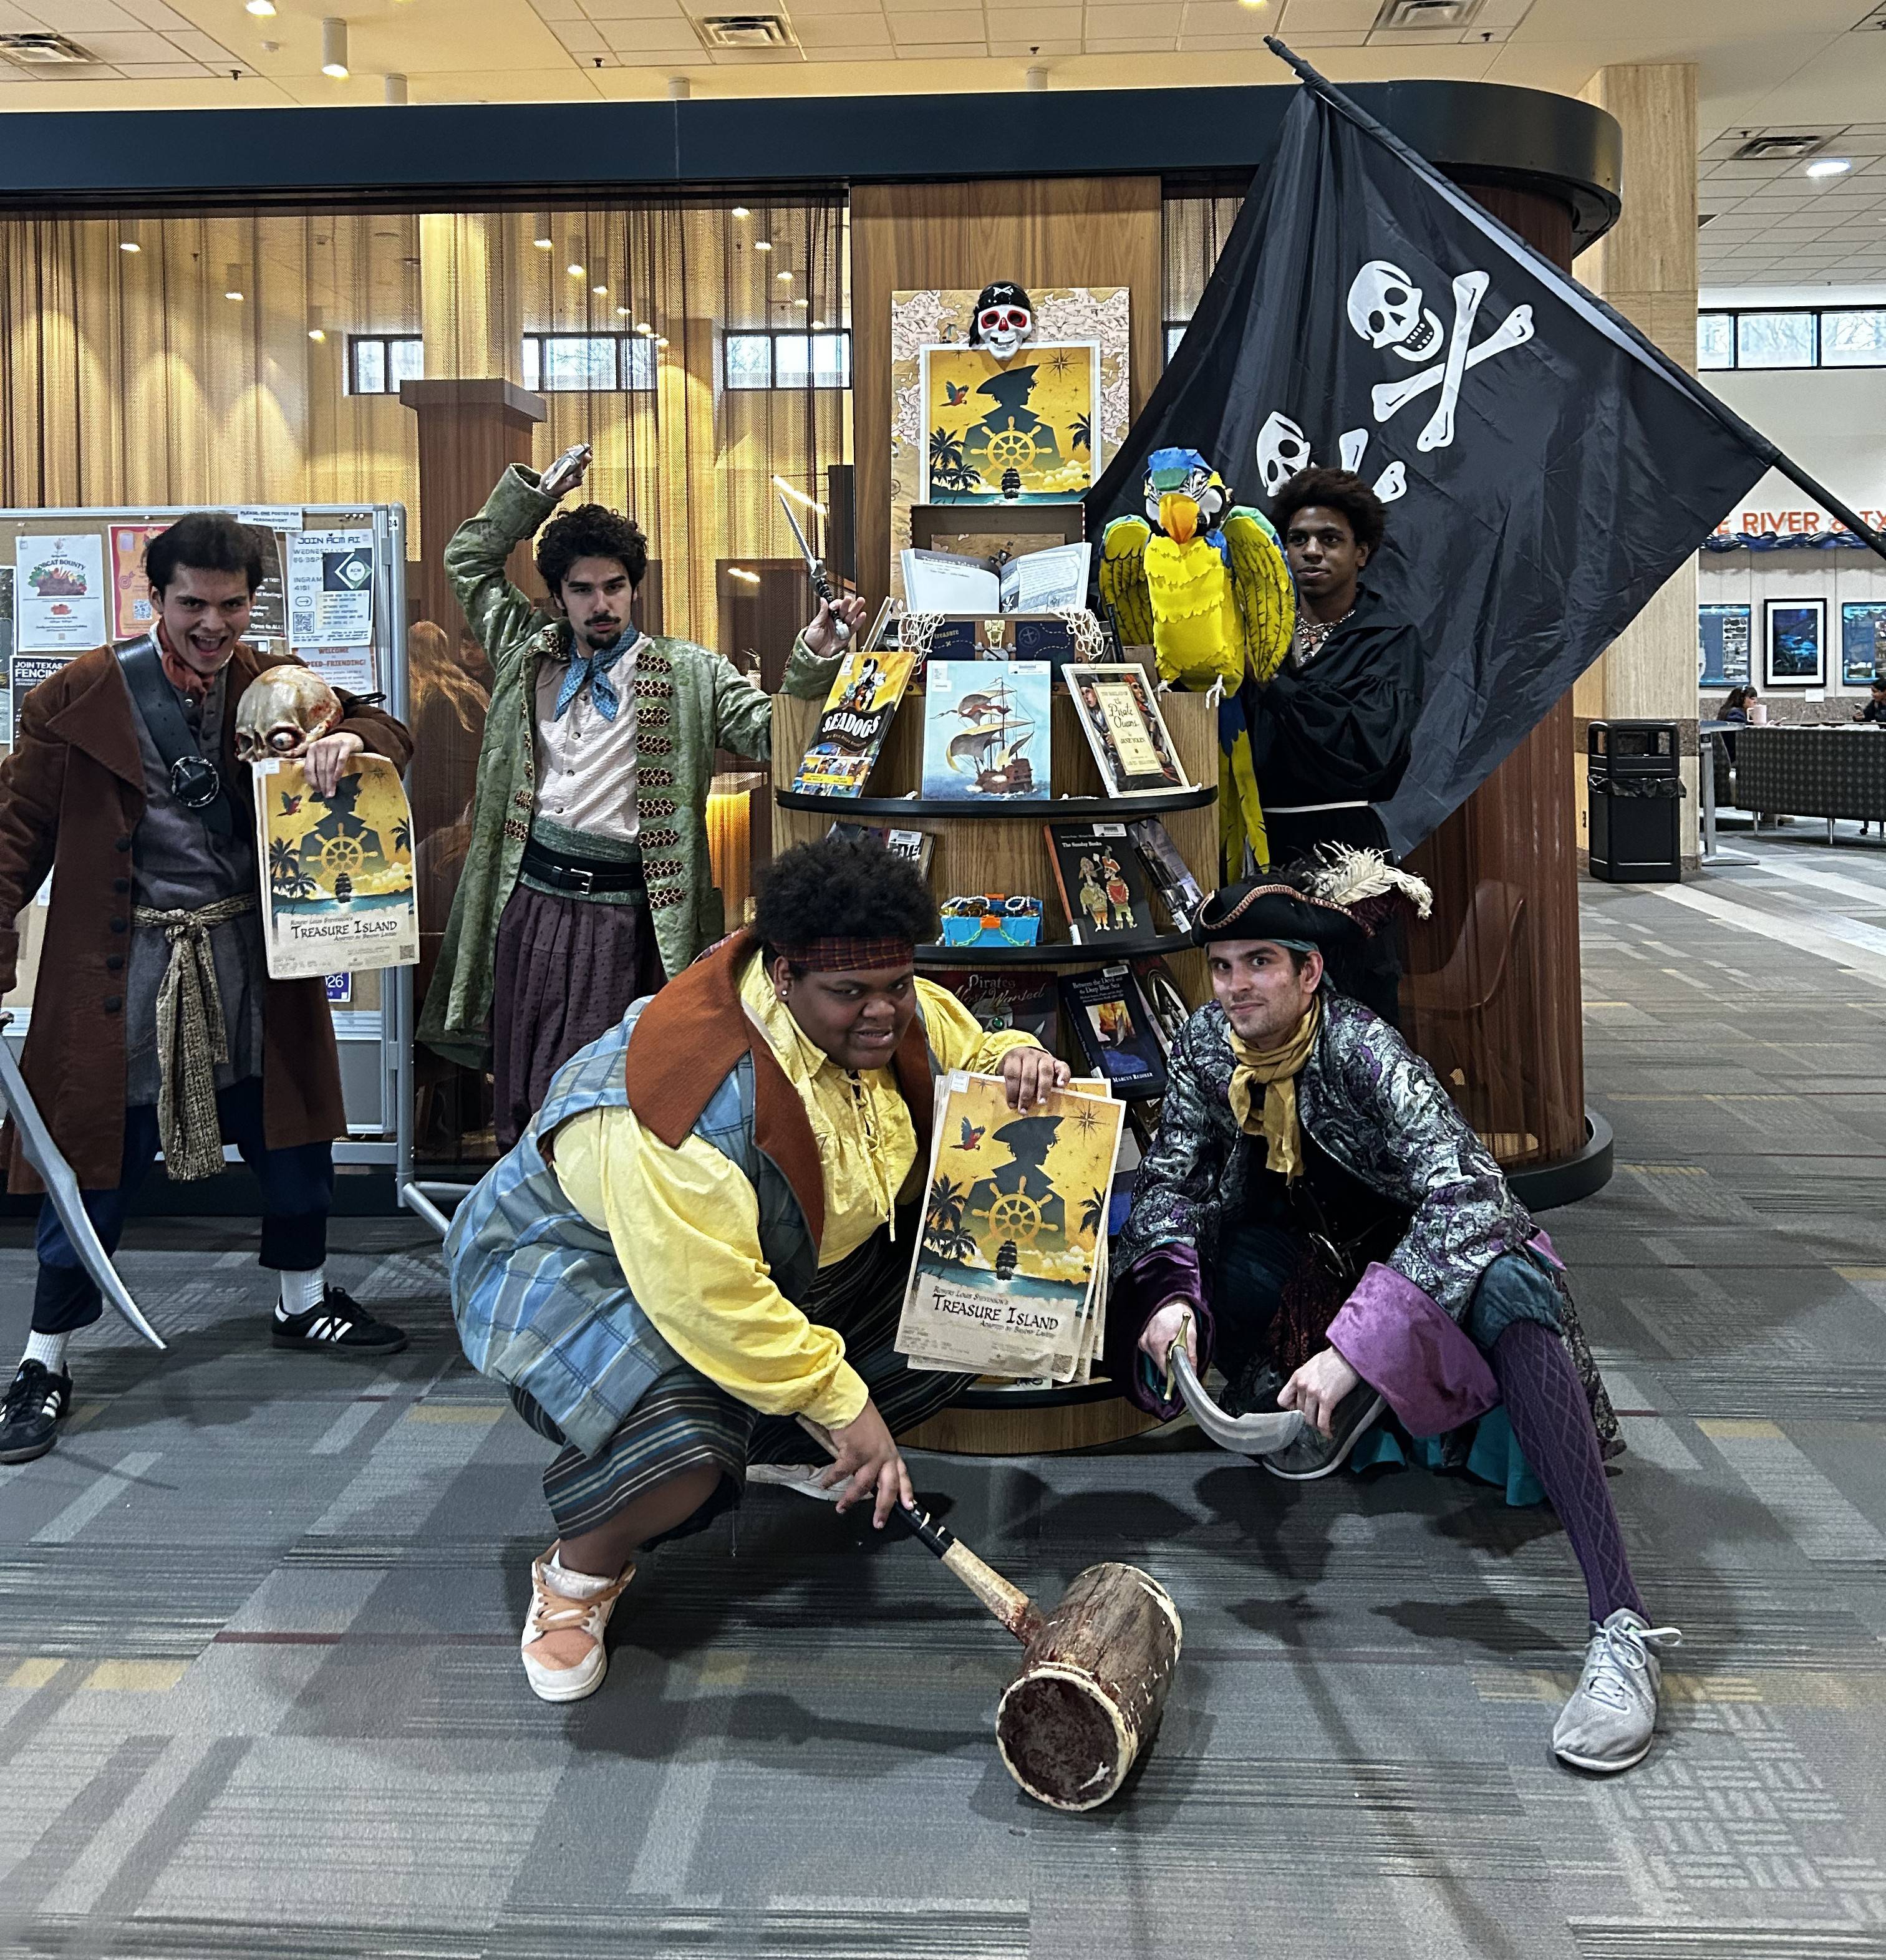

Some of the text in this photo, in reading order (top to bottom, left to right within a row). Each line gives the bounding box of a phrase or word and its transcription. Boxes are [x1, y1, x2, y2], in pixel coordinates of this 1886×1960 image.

[1743, 511, 1820, 534] RIVER
[59, 559, 87, 571] BOUNTY
[306, 659, 366, 667] PEED-FRIENDING!
[15, 669, 56, 678] FENCIN
[822, 712, 881, 738] SEADOGS
[291, 920, 398, 939] TREASURE ISLAND
[969, 973, 1016, 990] Pirates
[989, 982, 1047, 1007] Wanted
[932, 1293, 1059, 1330] TREASURE ISLAND
